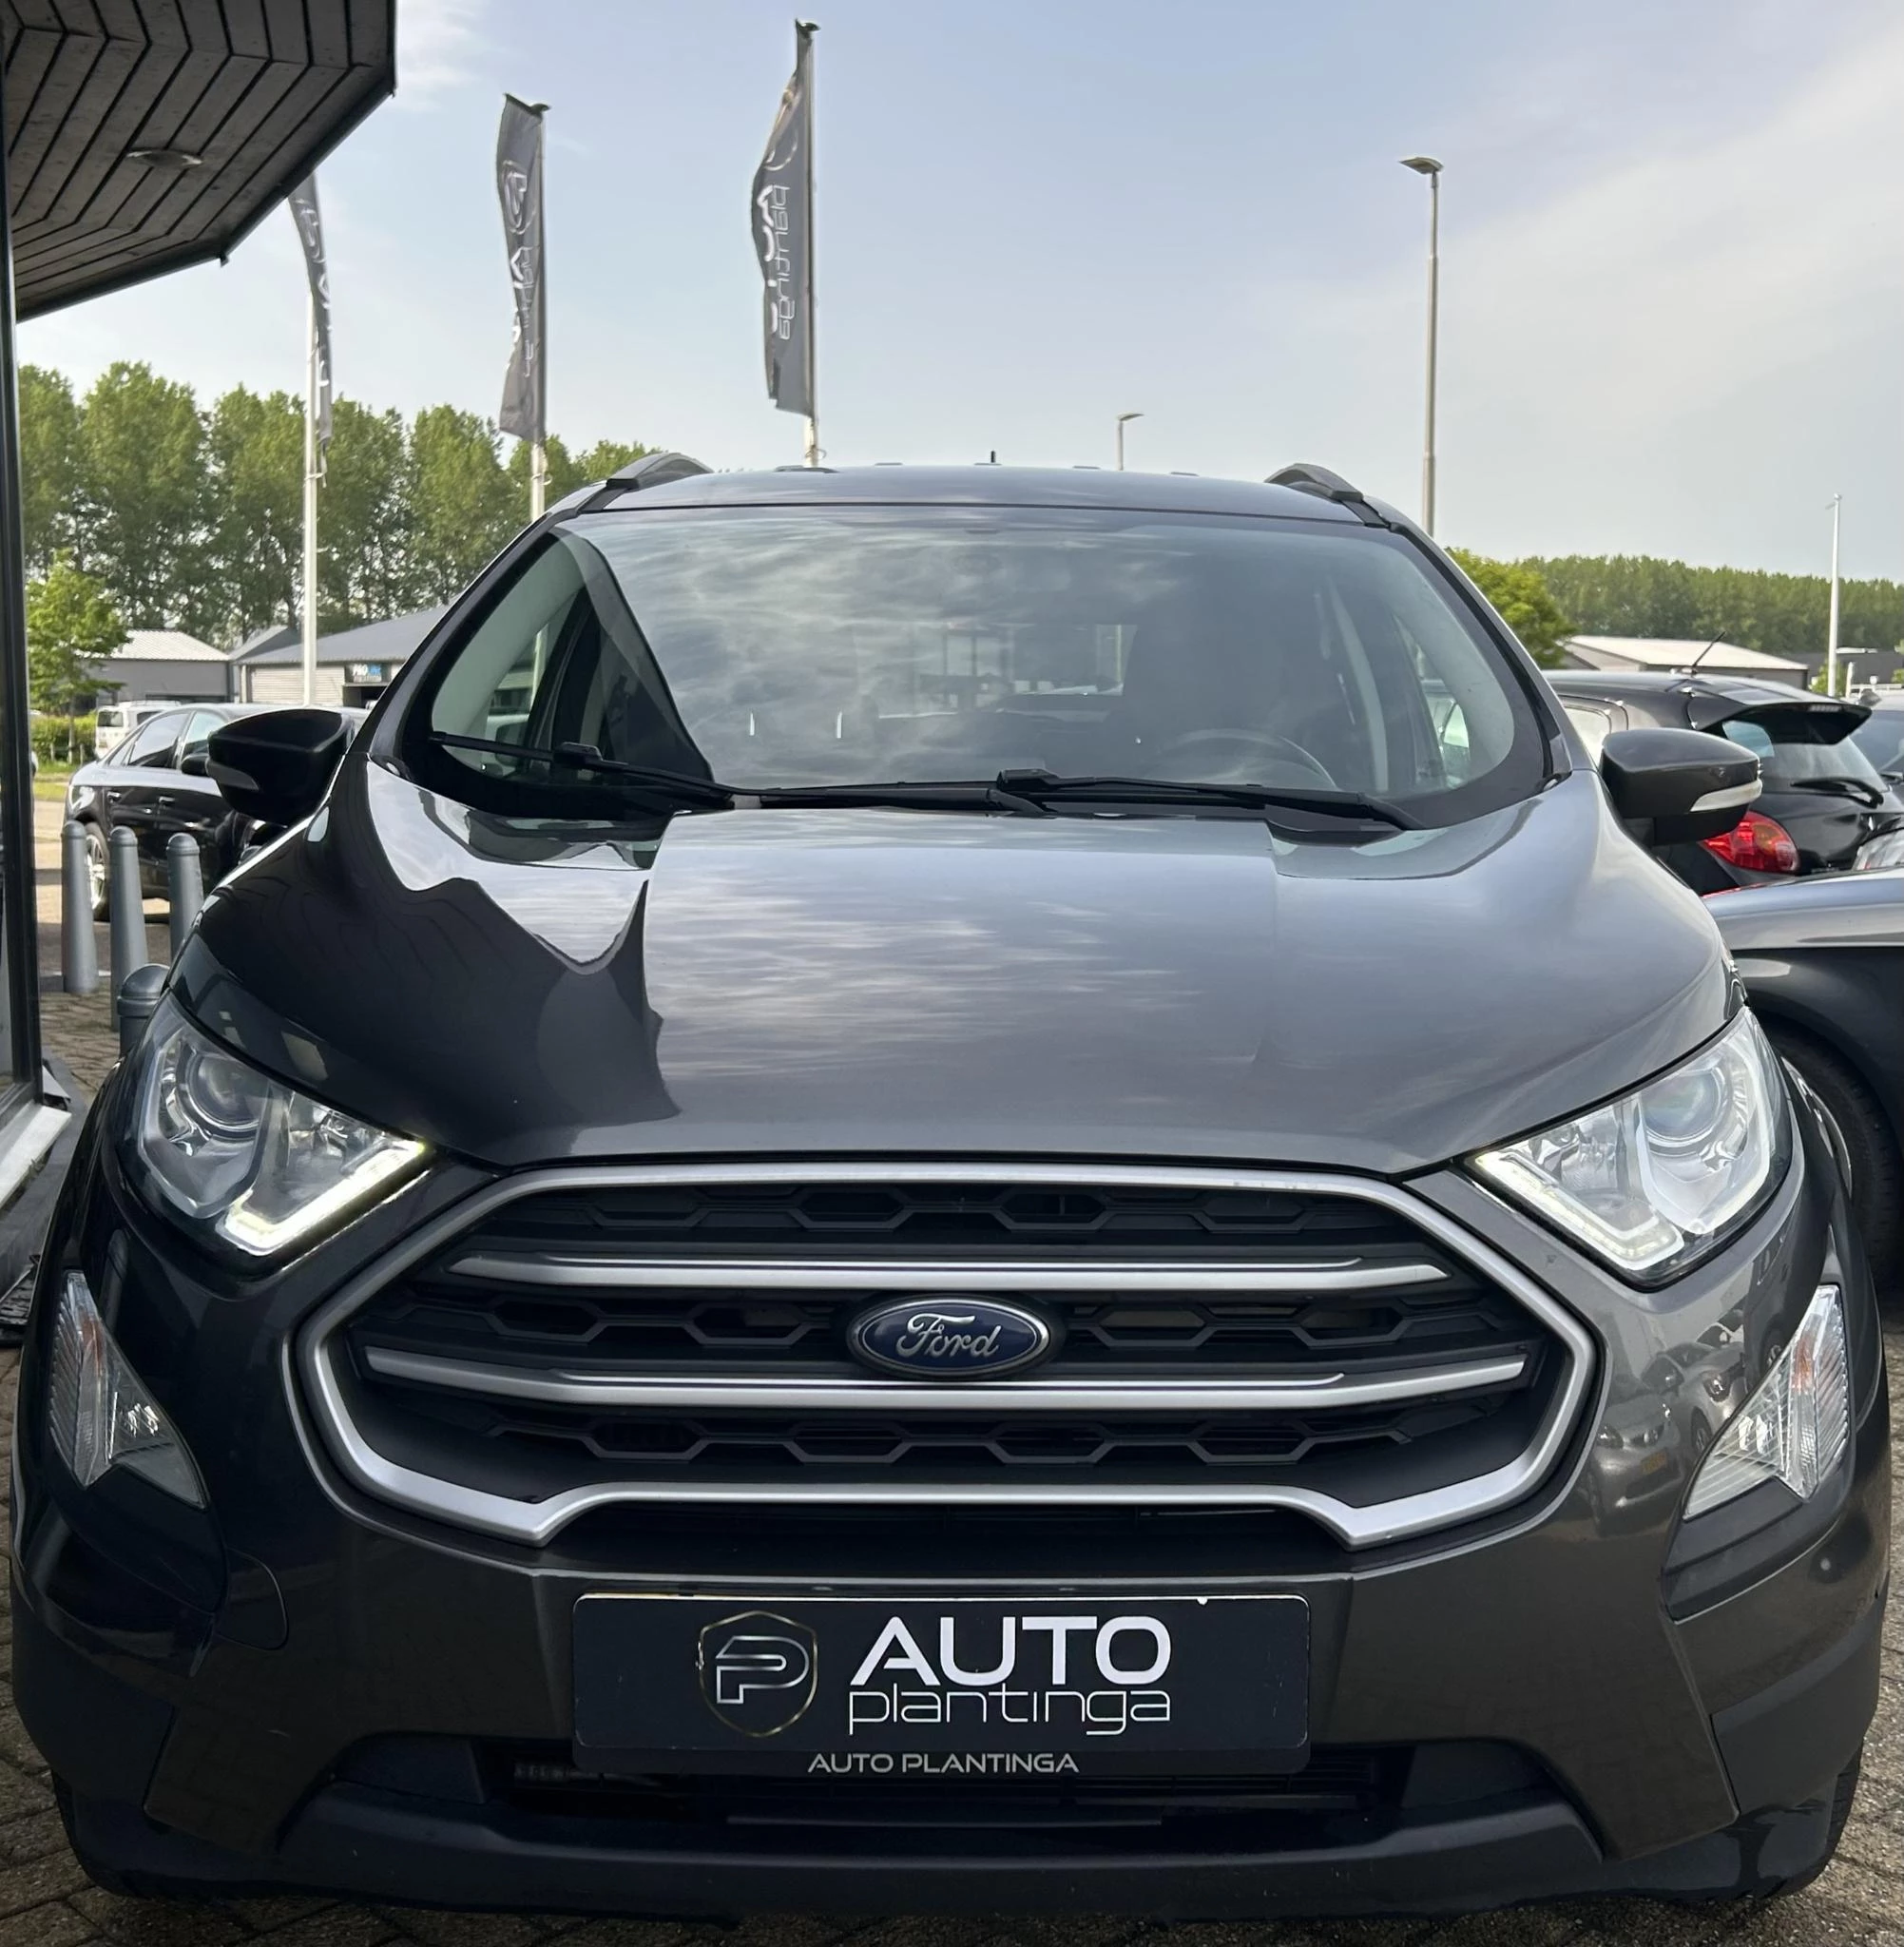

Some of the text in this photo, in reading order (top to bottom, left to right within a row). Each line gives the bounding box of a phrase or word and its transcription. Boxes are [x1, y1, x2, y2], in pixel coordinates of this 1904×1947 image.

[895, 1313, 1002, 1358] Ford
[851, 1617, 1170, 1685] AUTO
[850, 1683, 1170, 1735] plantinga
[808, 1754, 1079, 1772] AUTO PLANTINGA
